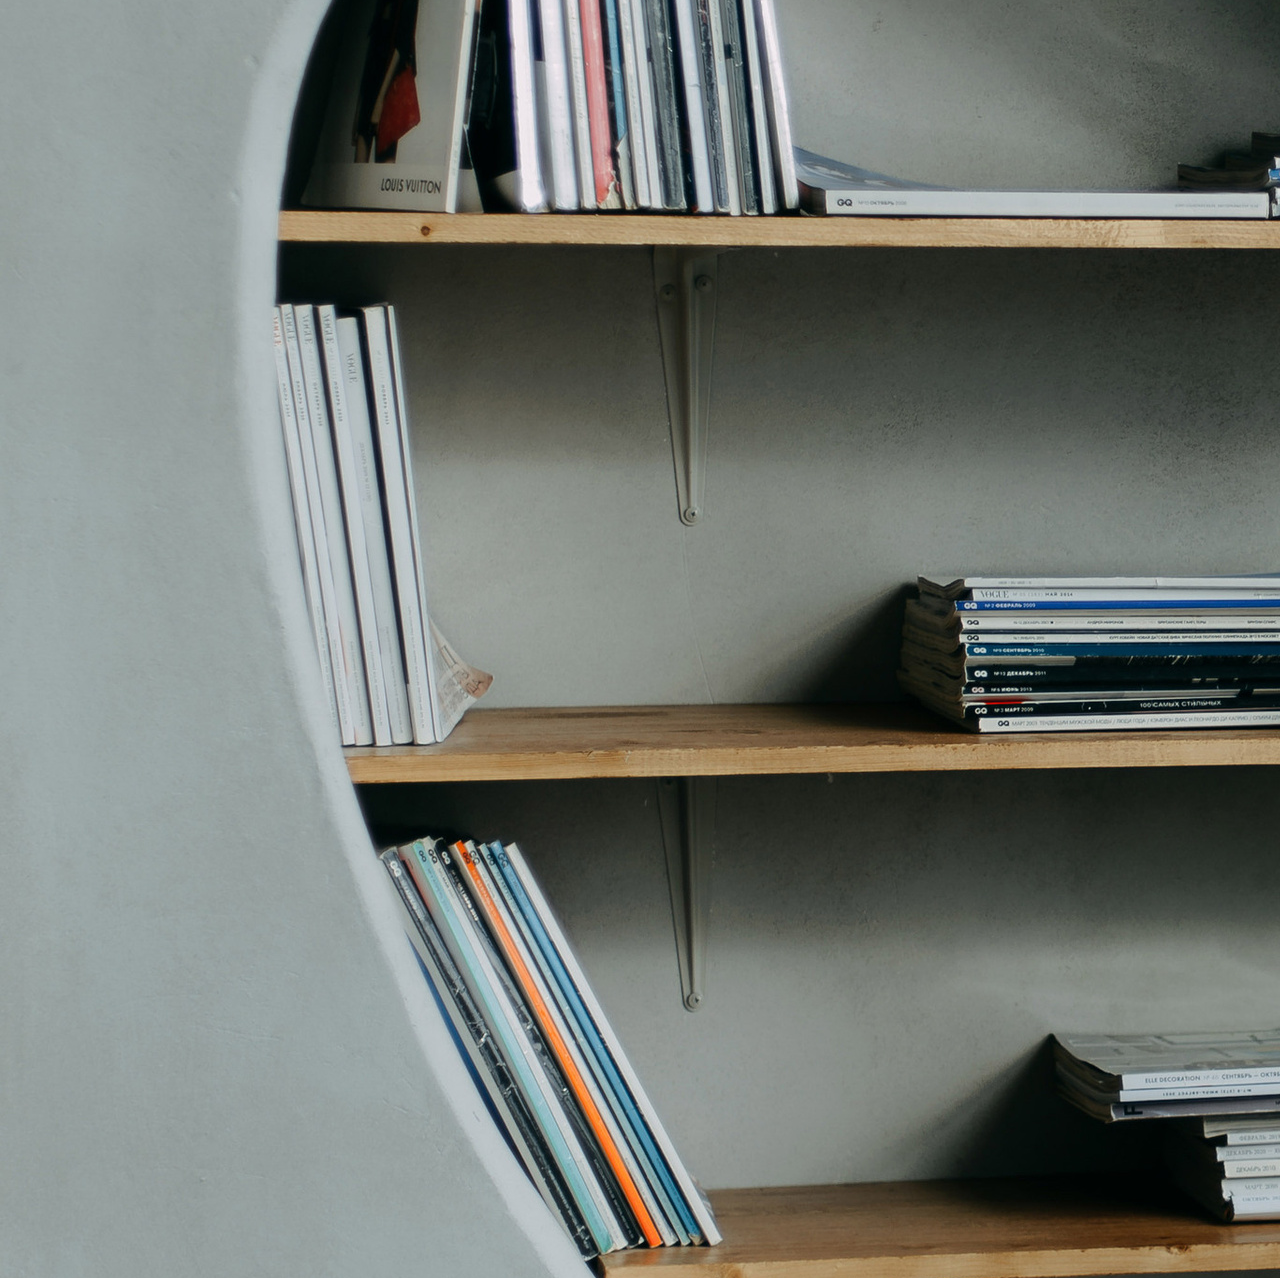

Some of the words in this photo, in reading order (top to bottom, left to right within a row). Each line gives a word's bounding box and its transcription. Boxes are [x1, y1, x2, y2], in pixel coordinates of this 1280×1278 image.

[381, 178, 404, 192] LOUIS
[406, 179, 441, 193] VUITTON
[273, 316, 282, 347] VOGUE
[285, 312, 295, 342] VOGUE
[302, 314, 313, 346] VOGUE
[323, 314, 334, 345] VOGUE
[347, 352, 358, 384] VOGUE
[980, 590, 1009, 598] VOGUE
[418, 850, 427, 863] GQ
[428, 849, 438, 864] GQ
[441, 851, 451, 865] GQ
[462, 852, 471, 864] GQ
[469, 850, 480, 865] GQ
[486, 854, 495, 866] GQ
[498, 853, 508, 868] GQ
[390, 860, 402, 877] GQ
[1124, 1105, 1143, 1116] F
